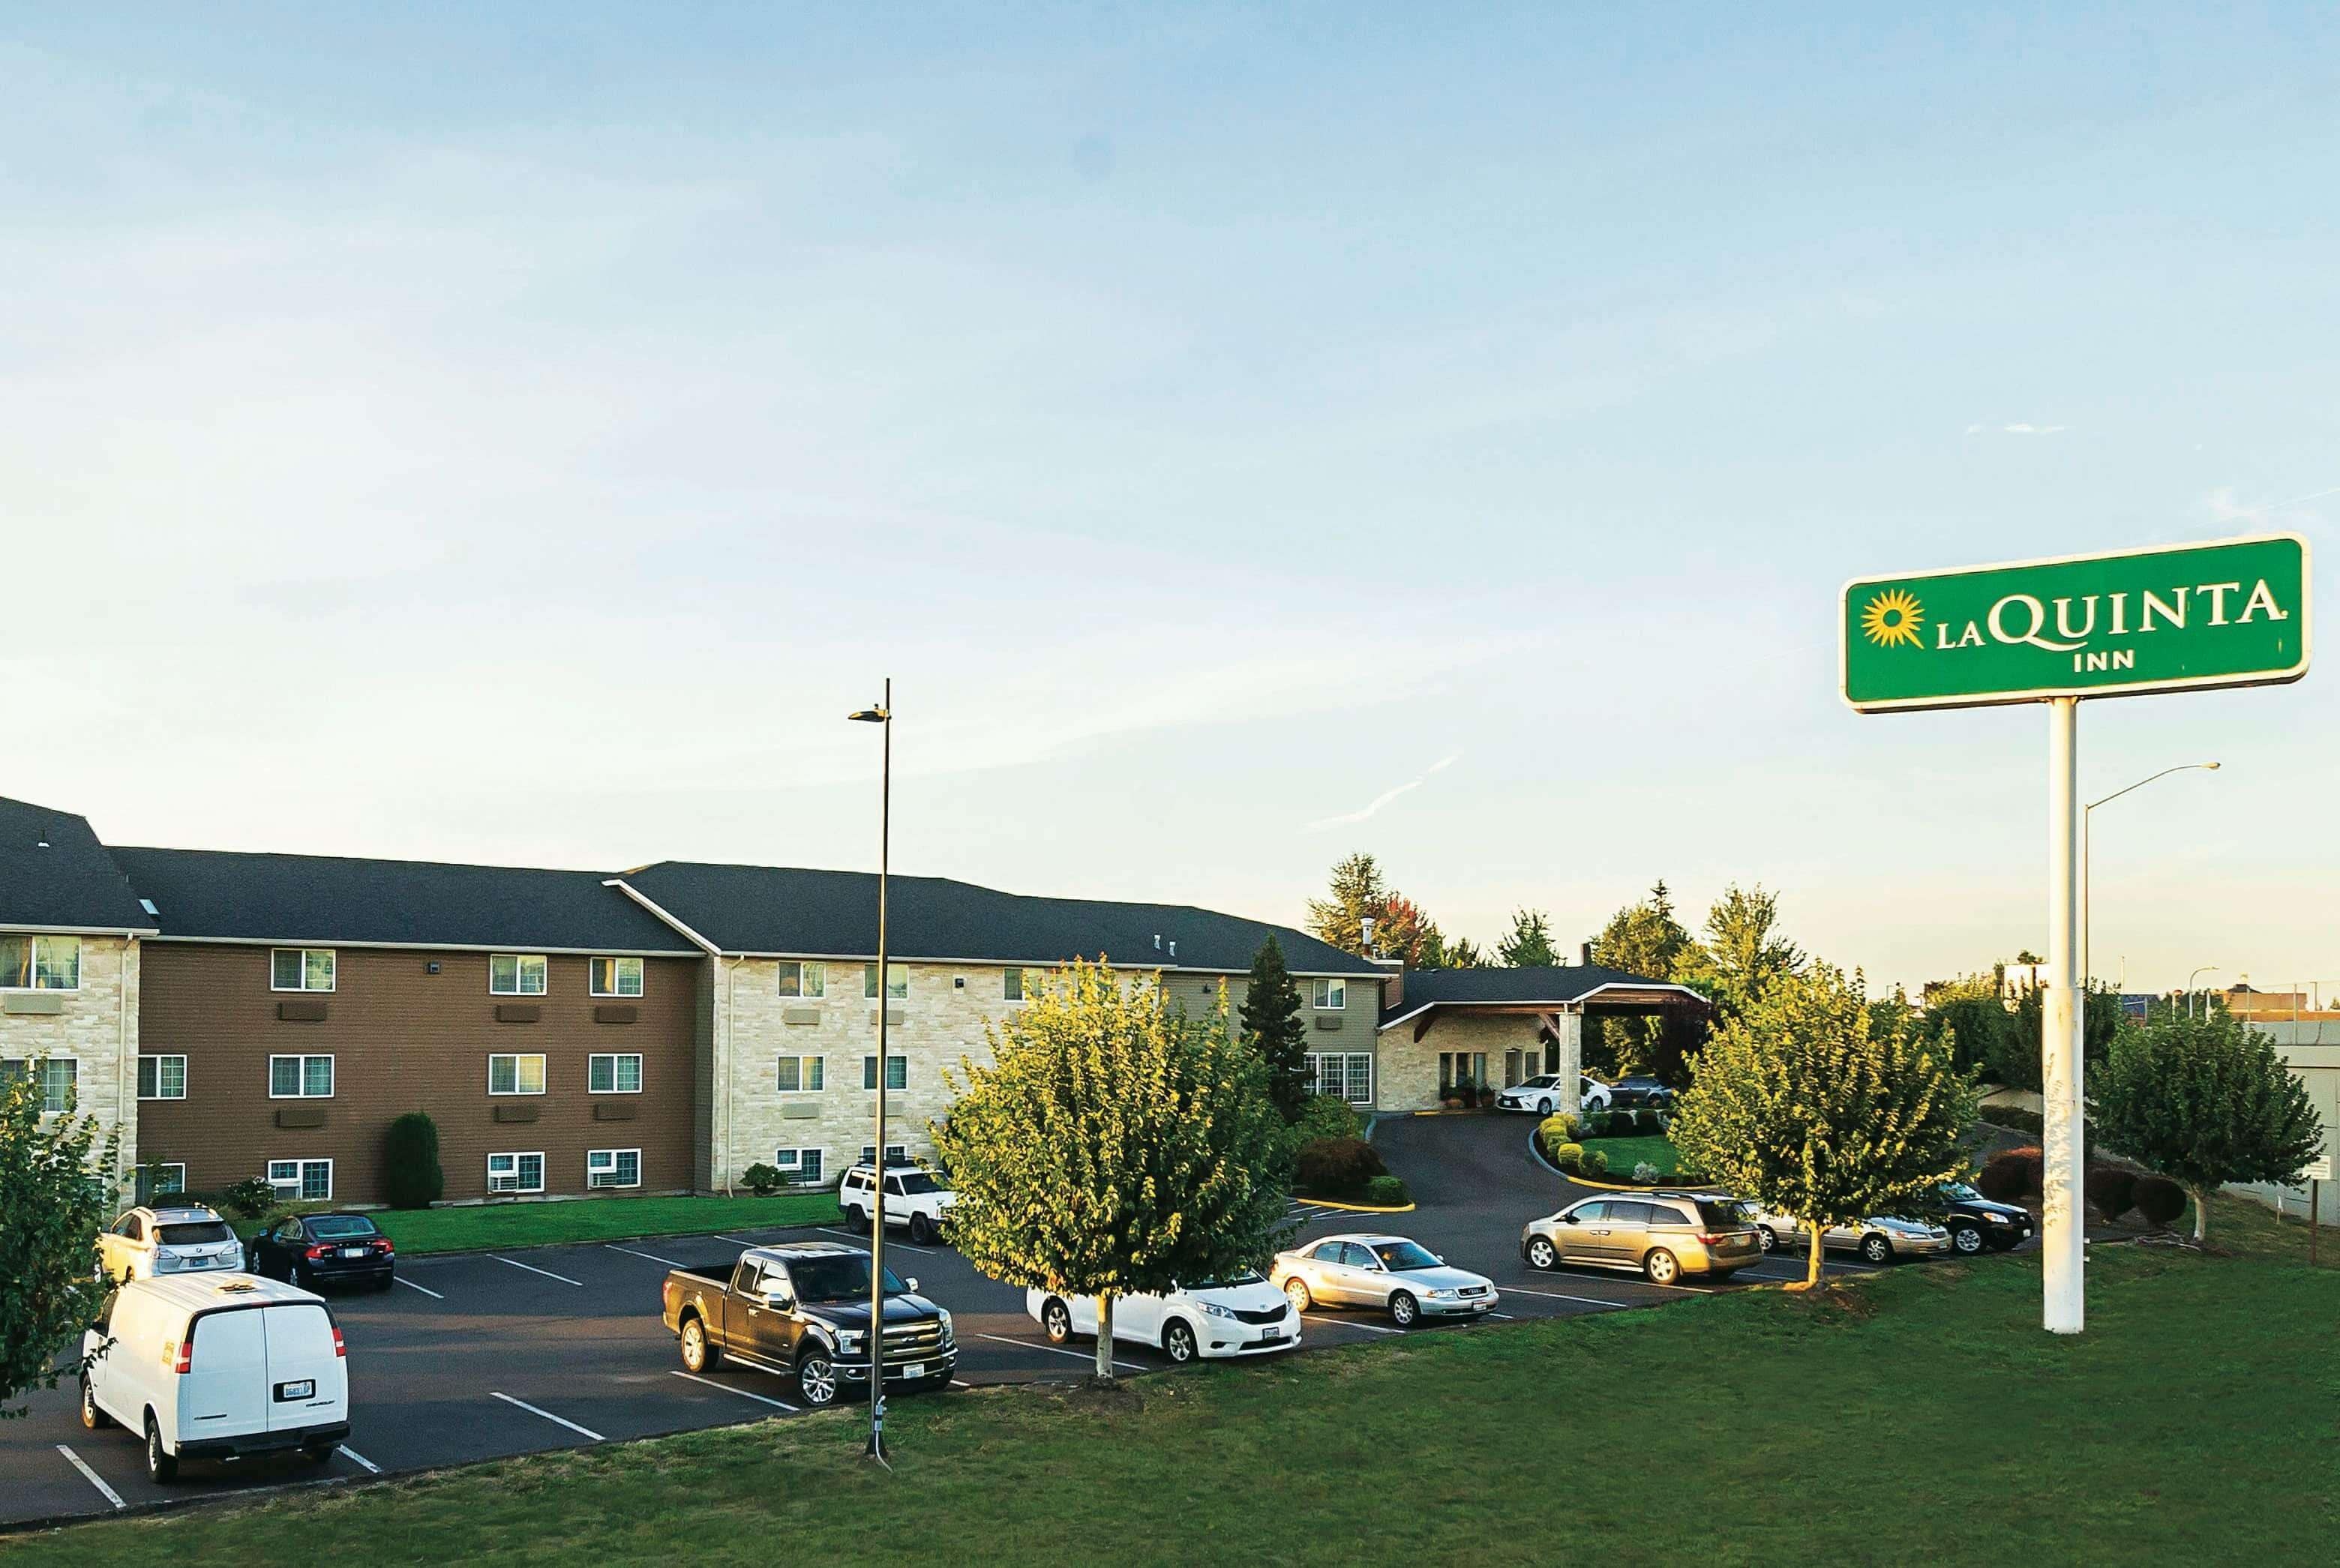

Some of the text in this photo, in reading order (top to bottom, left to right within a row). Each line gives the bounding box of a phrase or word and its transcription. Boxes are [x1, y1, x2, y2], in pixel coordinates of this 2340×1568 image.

[1936, 579, 2284, 652] LA QUINTA
[2074, 649, 2134, 673] INN
